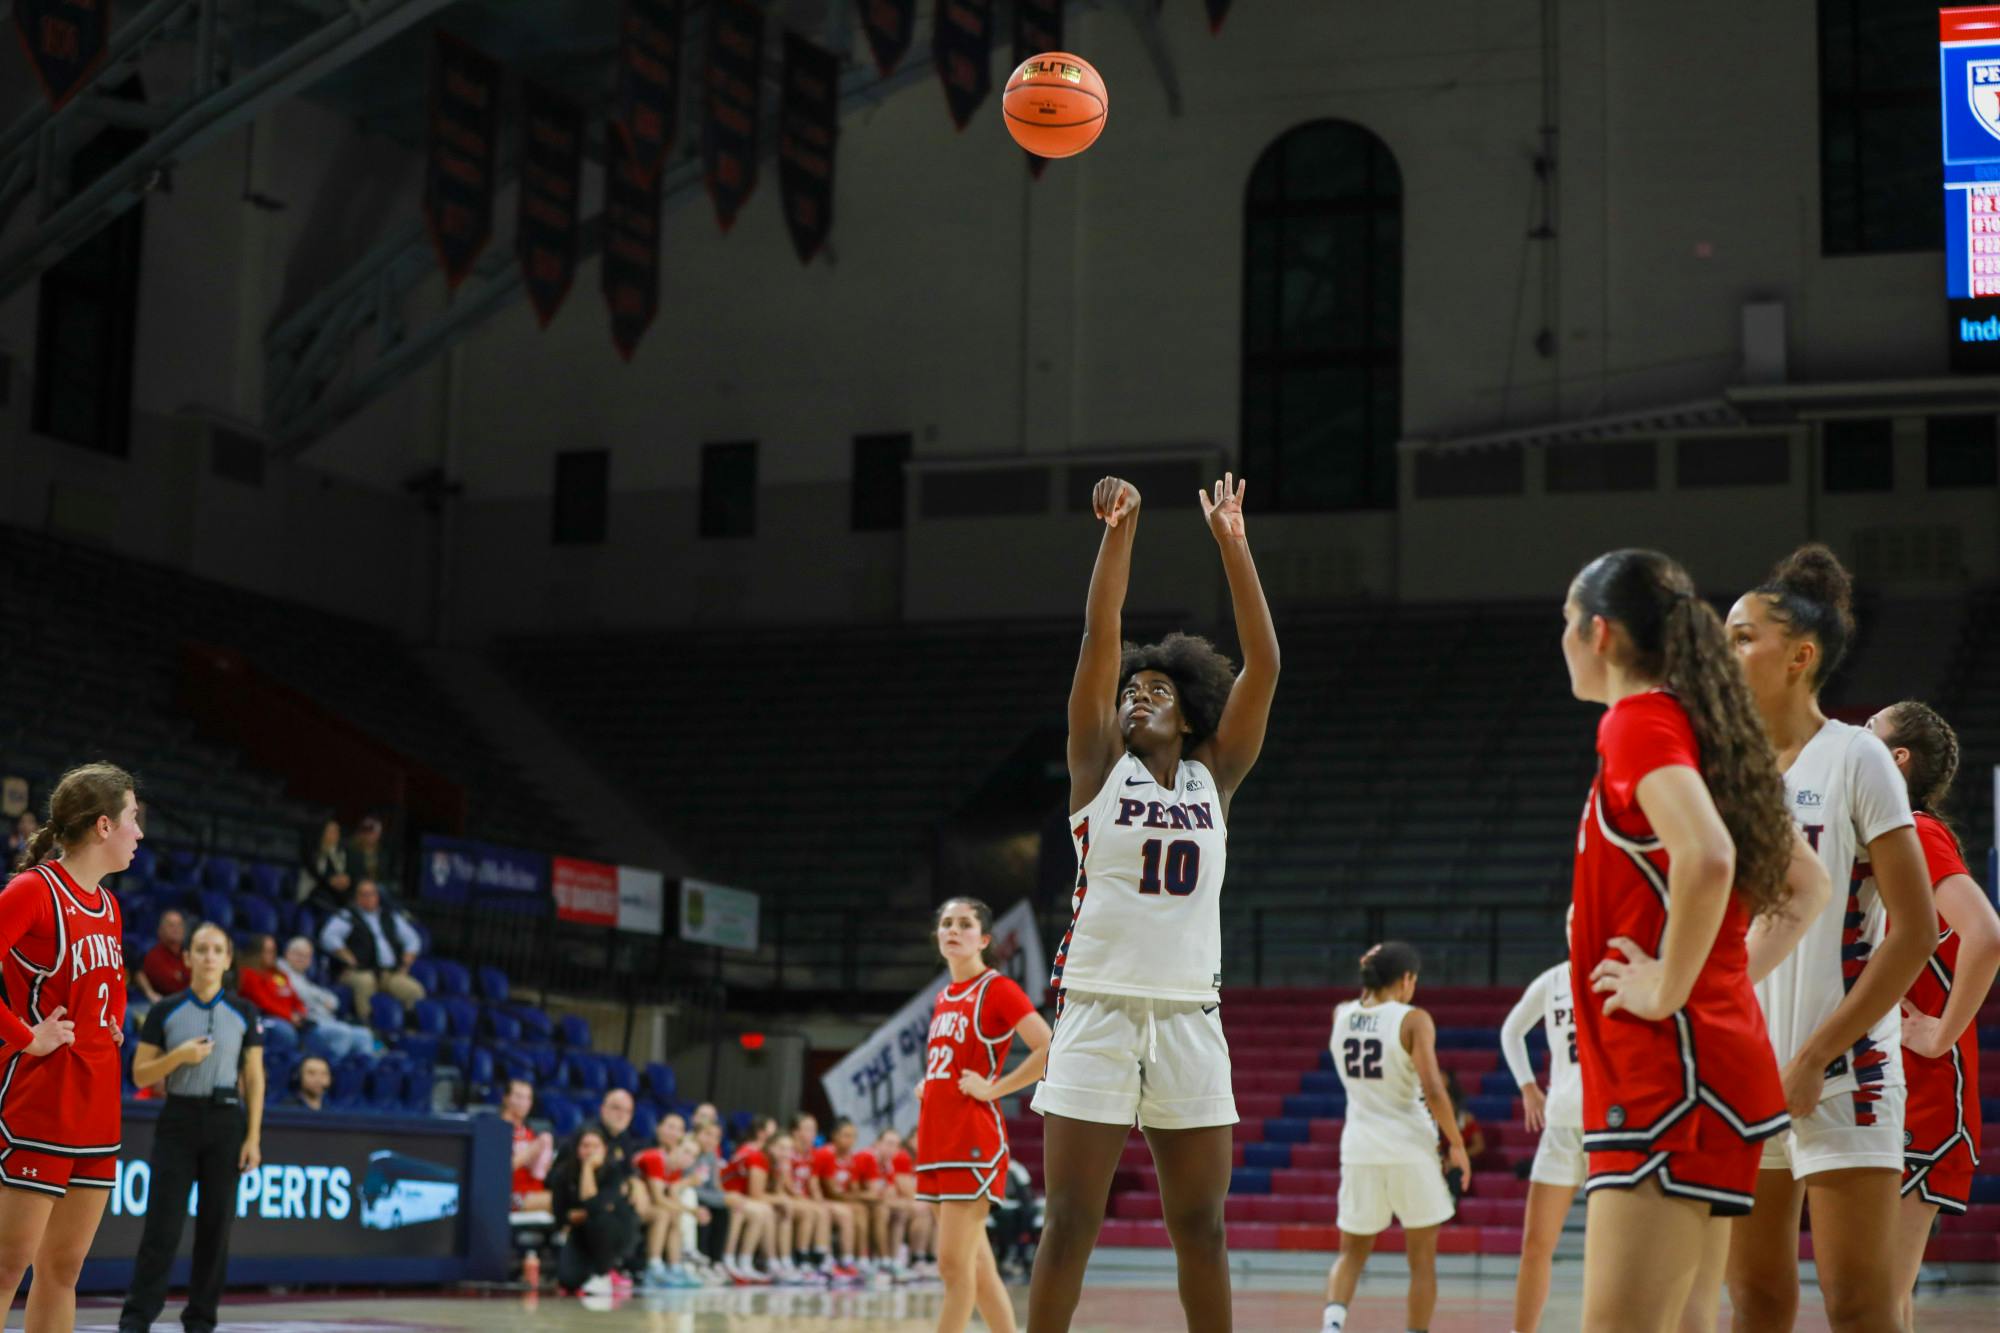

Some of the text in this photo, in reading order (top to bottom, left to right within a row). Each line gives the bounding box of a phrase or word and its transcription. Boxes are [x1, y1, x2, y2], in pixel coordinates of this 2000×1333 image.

[1024, 61, 1082, 76] ELITE
[1960, 315, 2000, 341] Ind
[1115, 797, 1214, 830] PENN
[1139, 838, 1200, 896] 10
[98, 982, 109, 1027] 2
[1350, 1013, 1379, 1032] GAYLE
[852, 1042, 895, 1096] THE
[927, 1045, 953, 1080] 22
[1343, 1037, 1383, 1079] 22
[236, 1162, 352, 1220] PERTS
